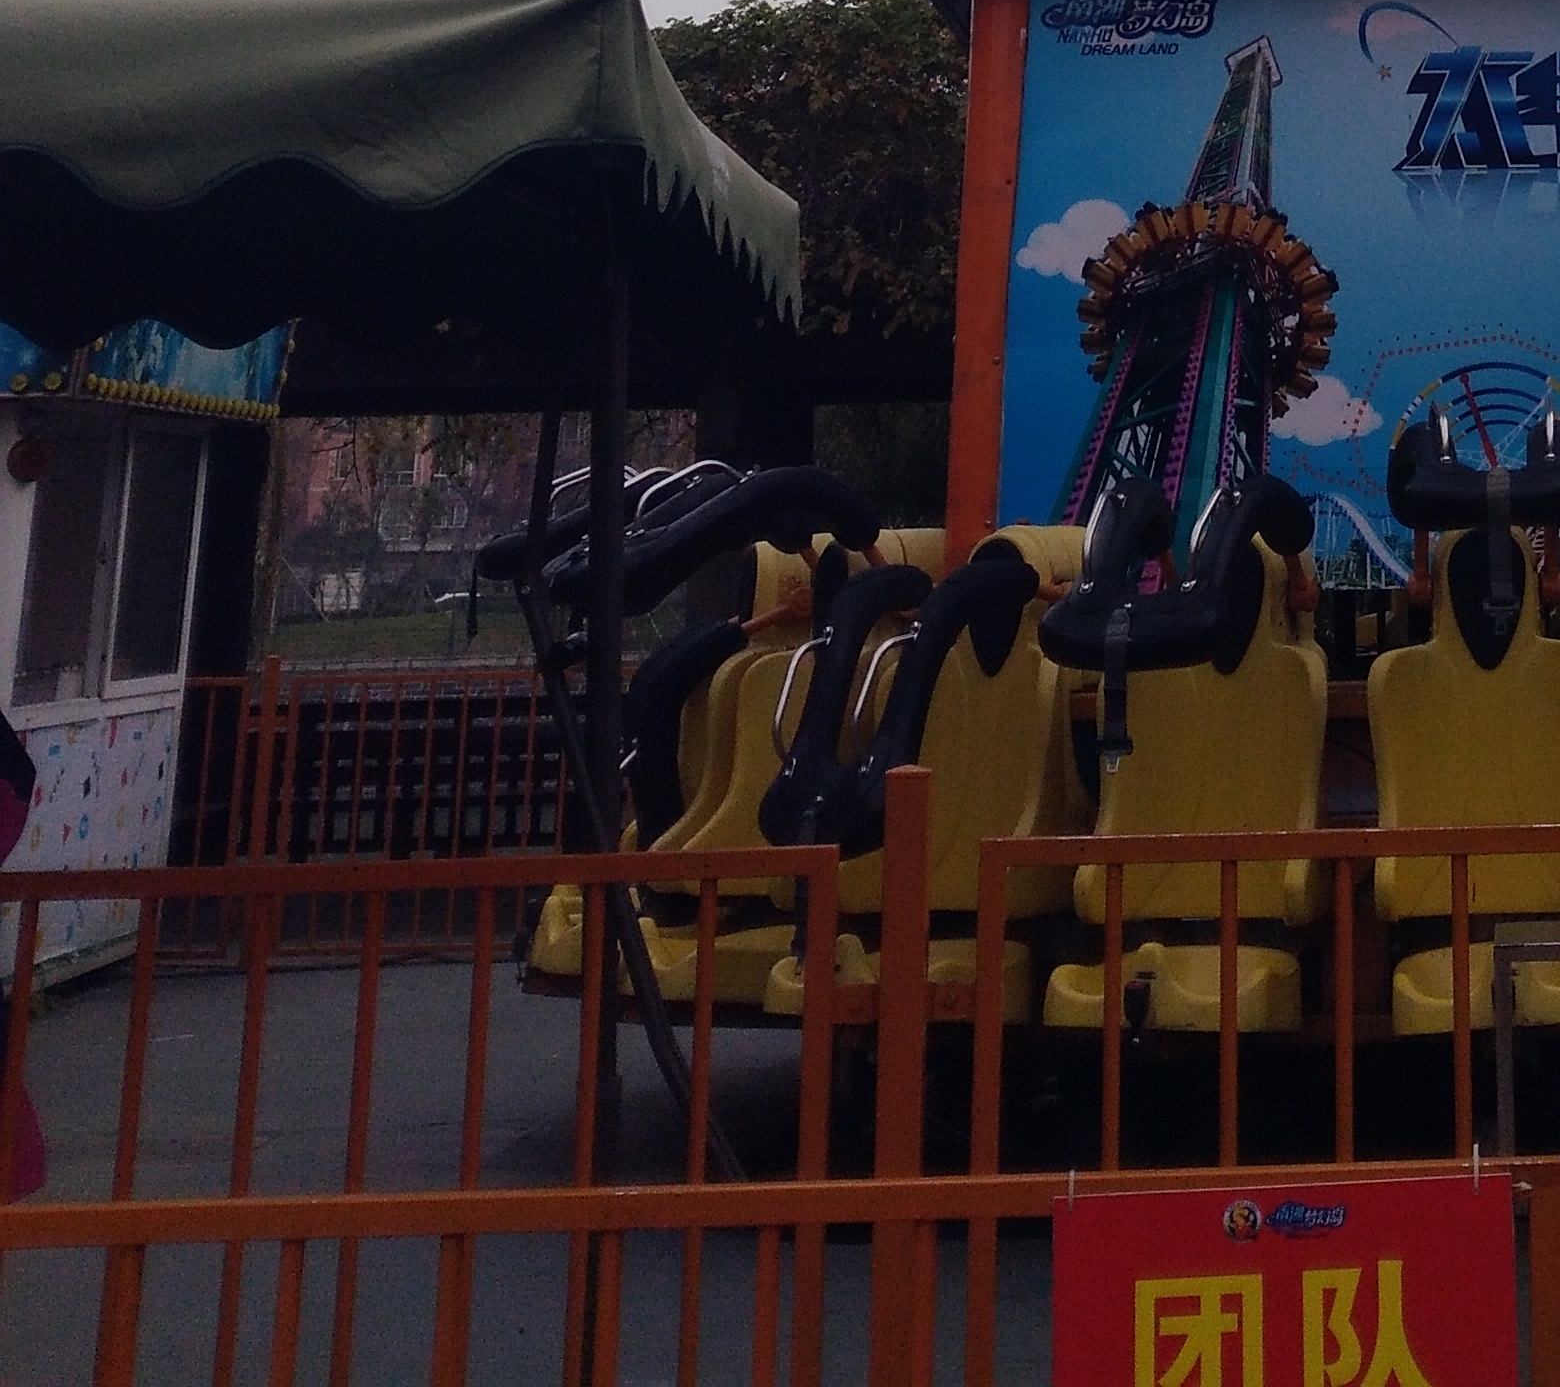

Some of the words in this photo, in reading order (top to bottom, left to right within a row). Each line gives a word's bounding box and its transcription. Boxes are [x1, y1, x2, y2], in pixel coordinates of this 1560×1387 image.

[1080, 43, 1136, 56] DREAM
[1138, 42, 1179, 56] LAND
[1134, 1259, 1432, 1387] 团队
